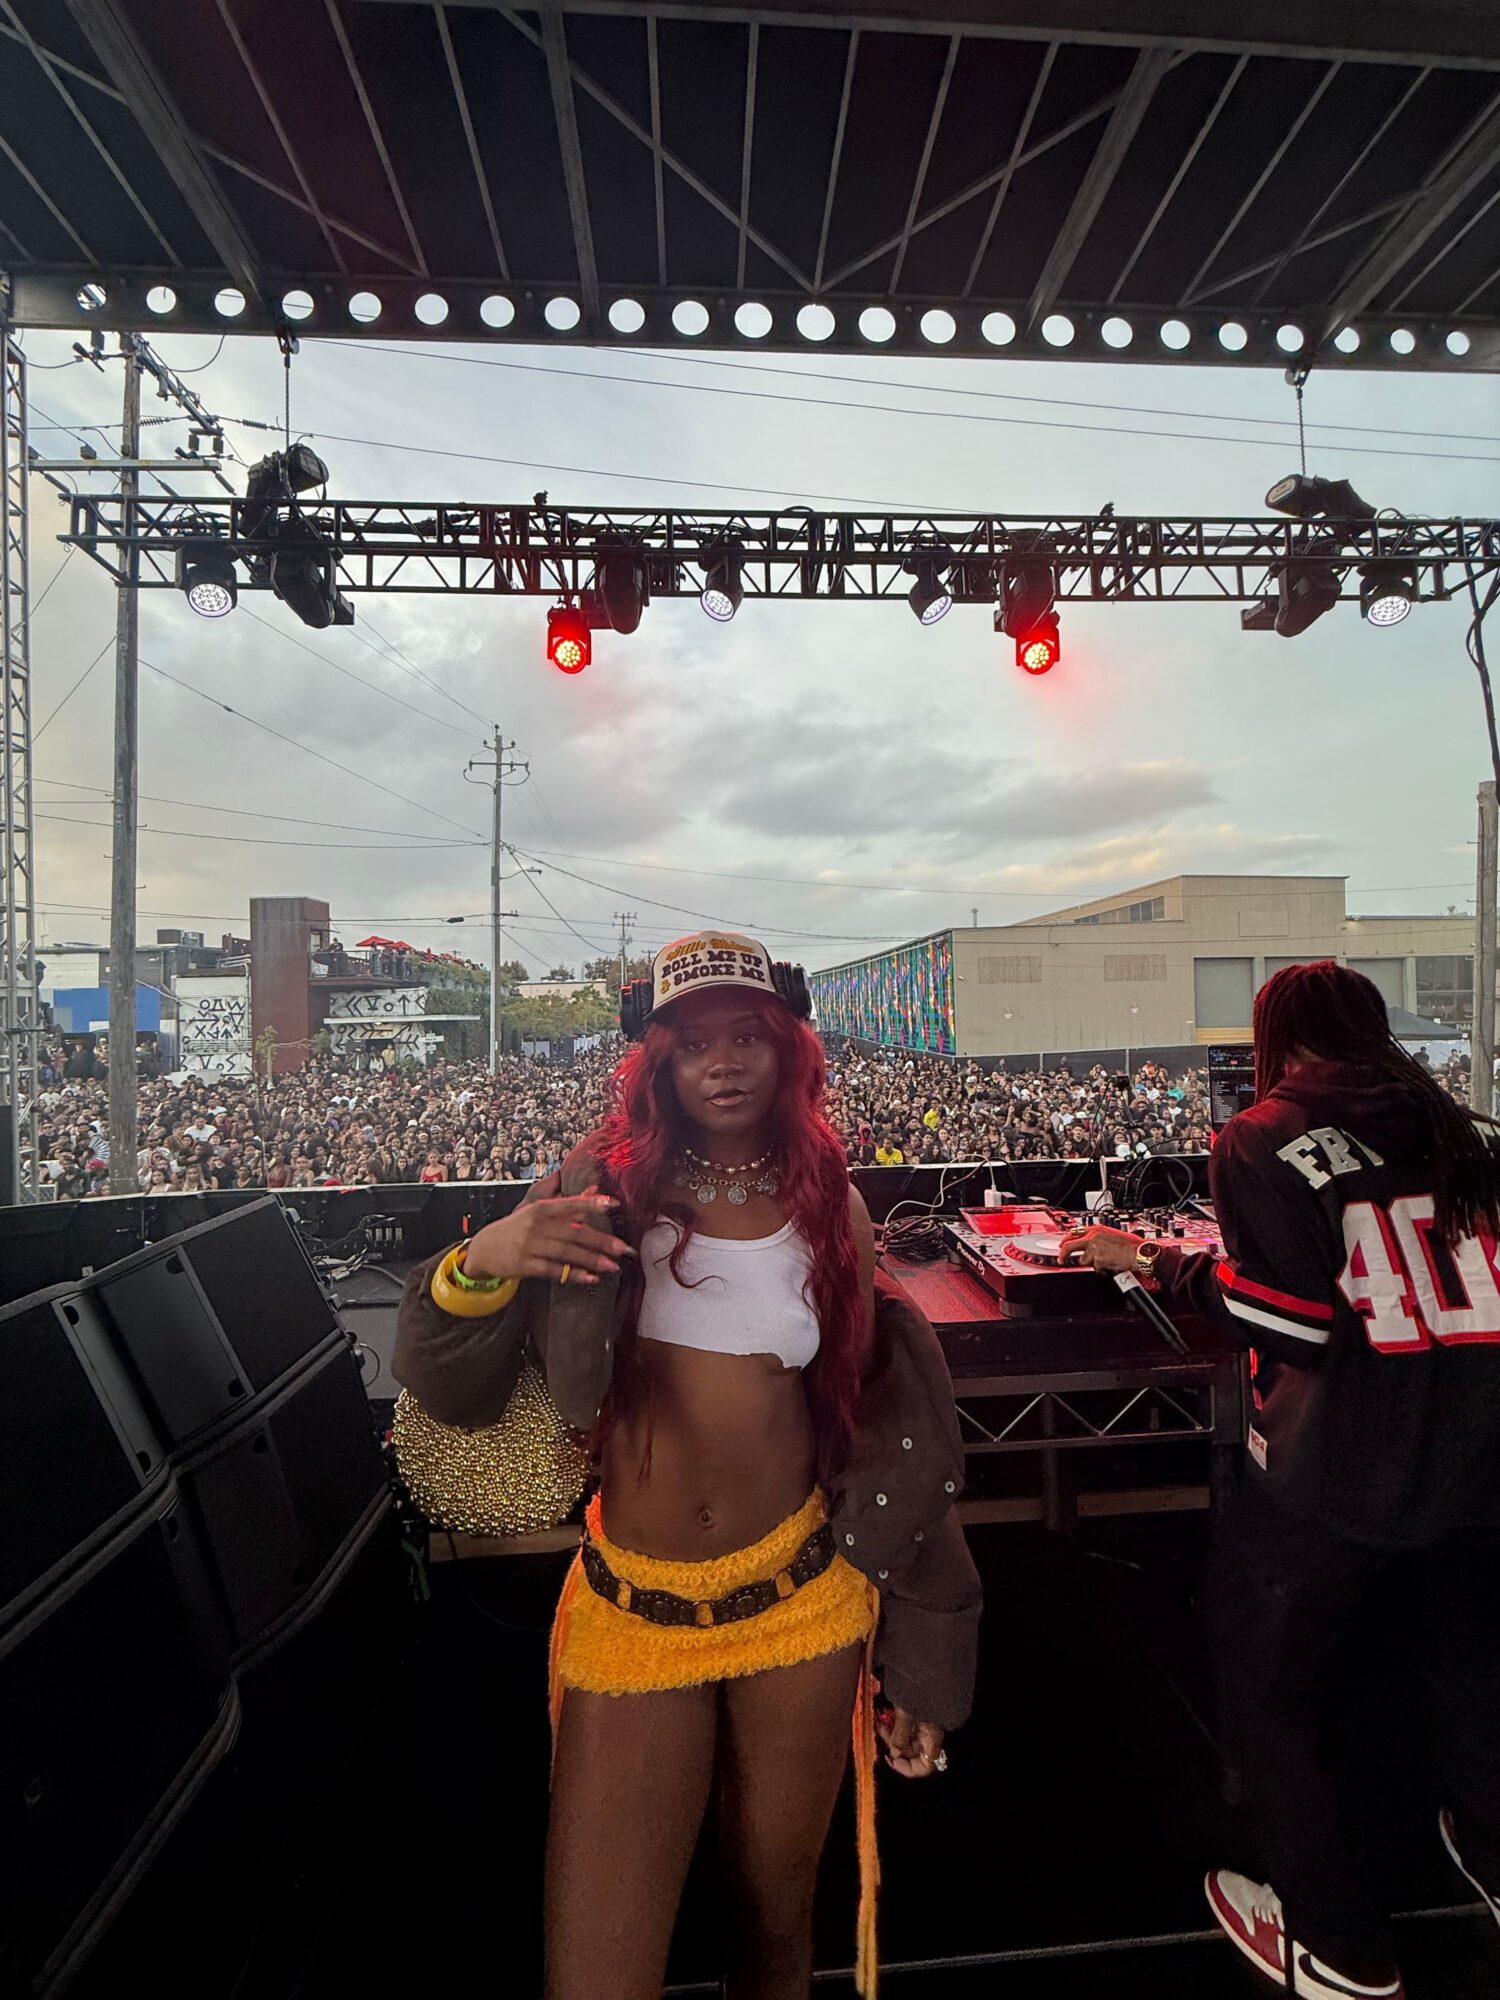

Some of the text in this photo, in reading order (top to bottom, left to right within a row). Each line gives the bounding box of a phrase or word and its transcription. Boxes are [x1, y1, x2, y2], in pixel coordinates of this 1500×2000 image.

[660, 963, 766, 994] & SMOKE ME
[661, 950, 764, 979] ROLL ME UP
